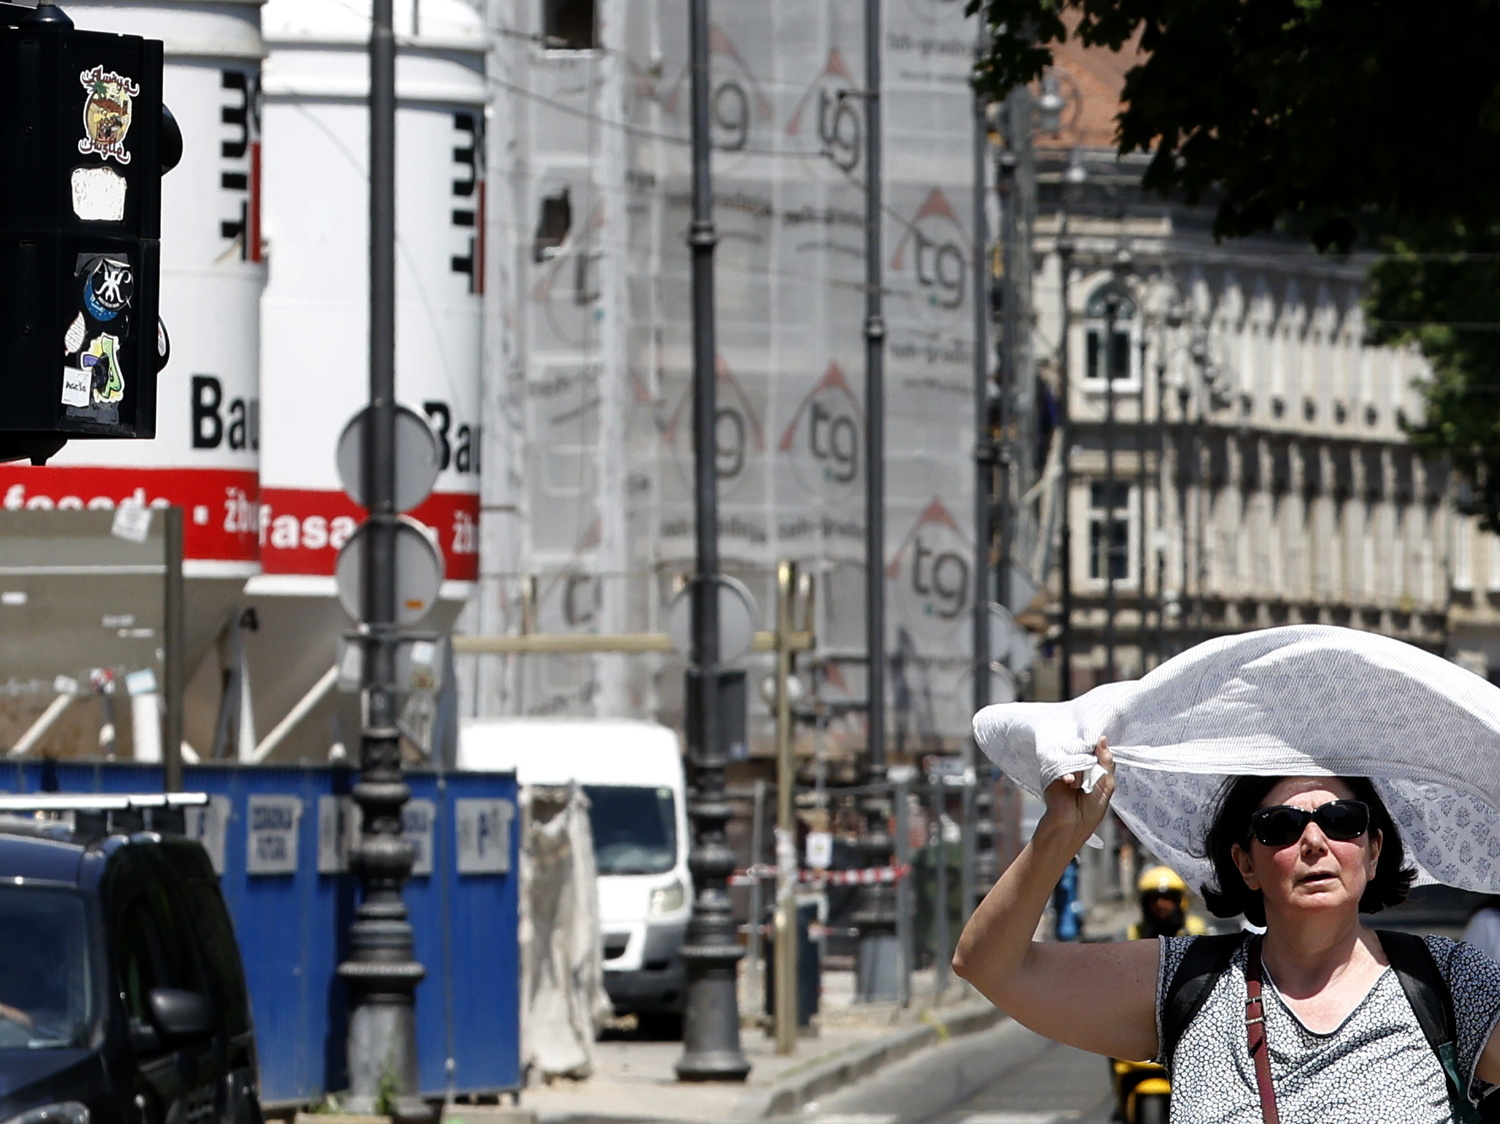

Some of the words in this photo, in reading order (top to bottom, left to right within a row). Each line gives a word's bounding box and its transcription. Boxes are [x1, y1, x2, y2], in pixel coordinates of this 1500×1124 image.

[80, 66, 139, 95] Always
[715, 83, 748, 151] g
[915, 228, 967, 311] tg
[714, 406, 745, 478] g
[809, 402, 859, 482] tg
[259, 504, 358, 549] fasa
[911, 538, 970, 619] tg
